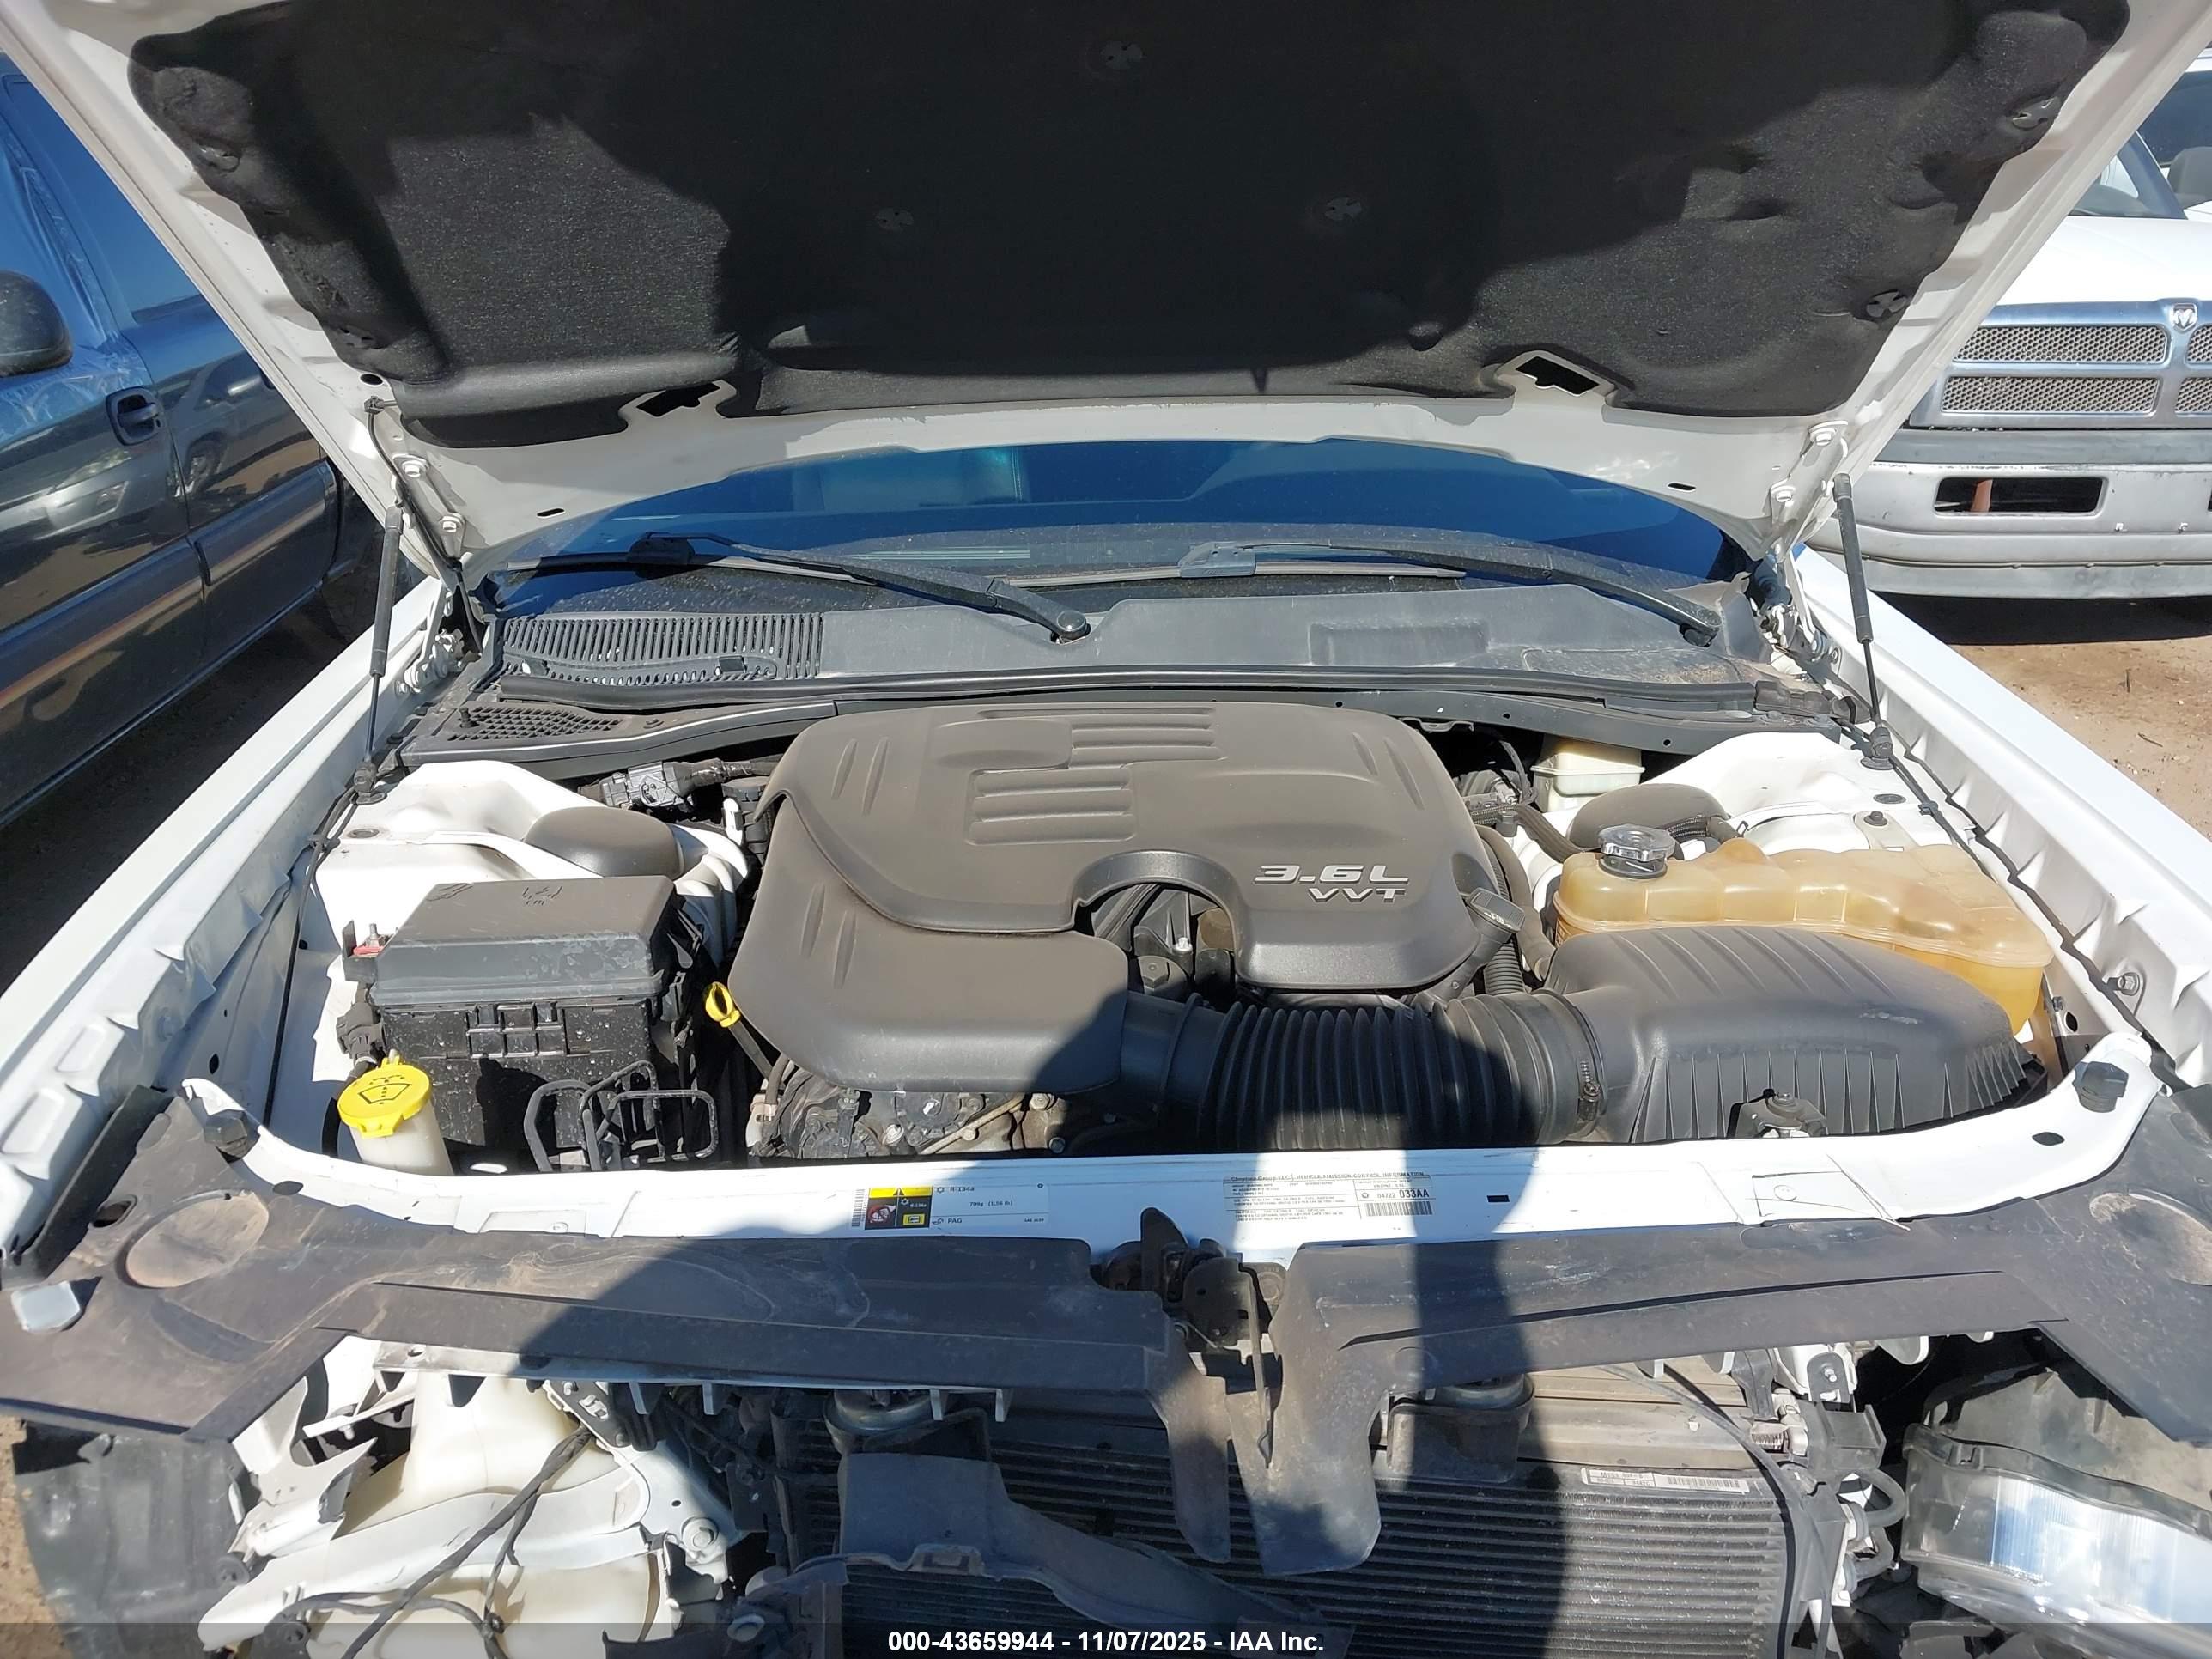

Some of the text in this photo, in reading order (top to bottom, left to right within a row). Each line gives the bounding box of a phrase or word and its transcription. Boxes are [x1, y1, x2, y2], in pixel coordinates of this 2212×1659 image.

[1254, 865, 1409, 884] 3.6L
[1308, 888, 1405, 903] VVT
[1399, 1189, 1430, 1198] 033AA
